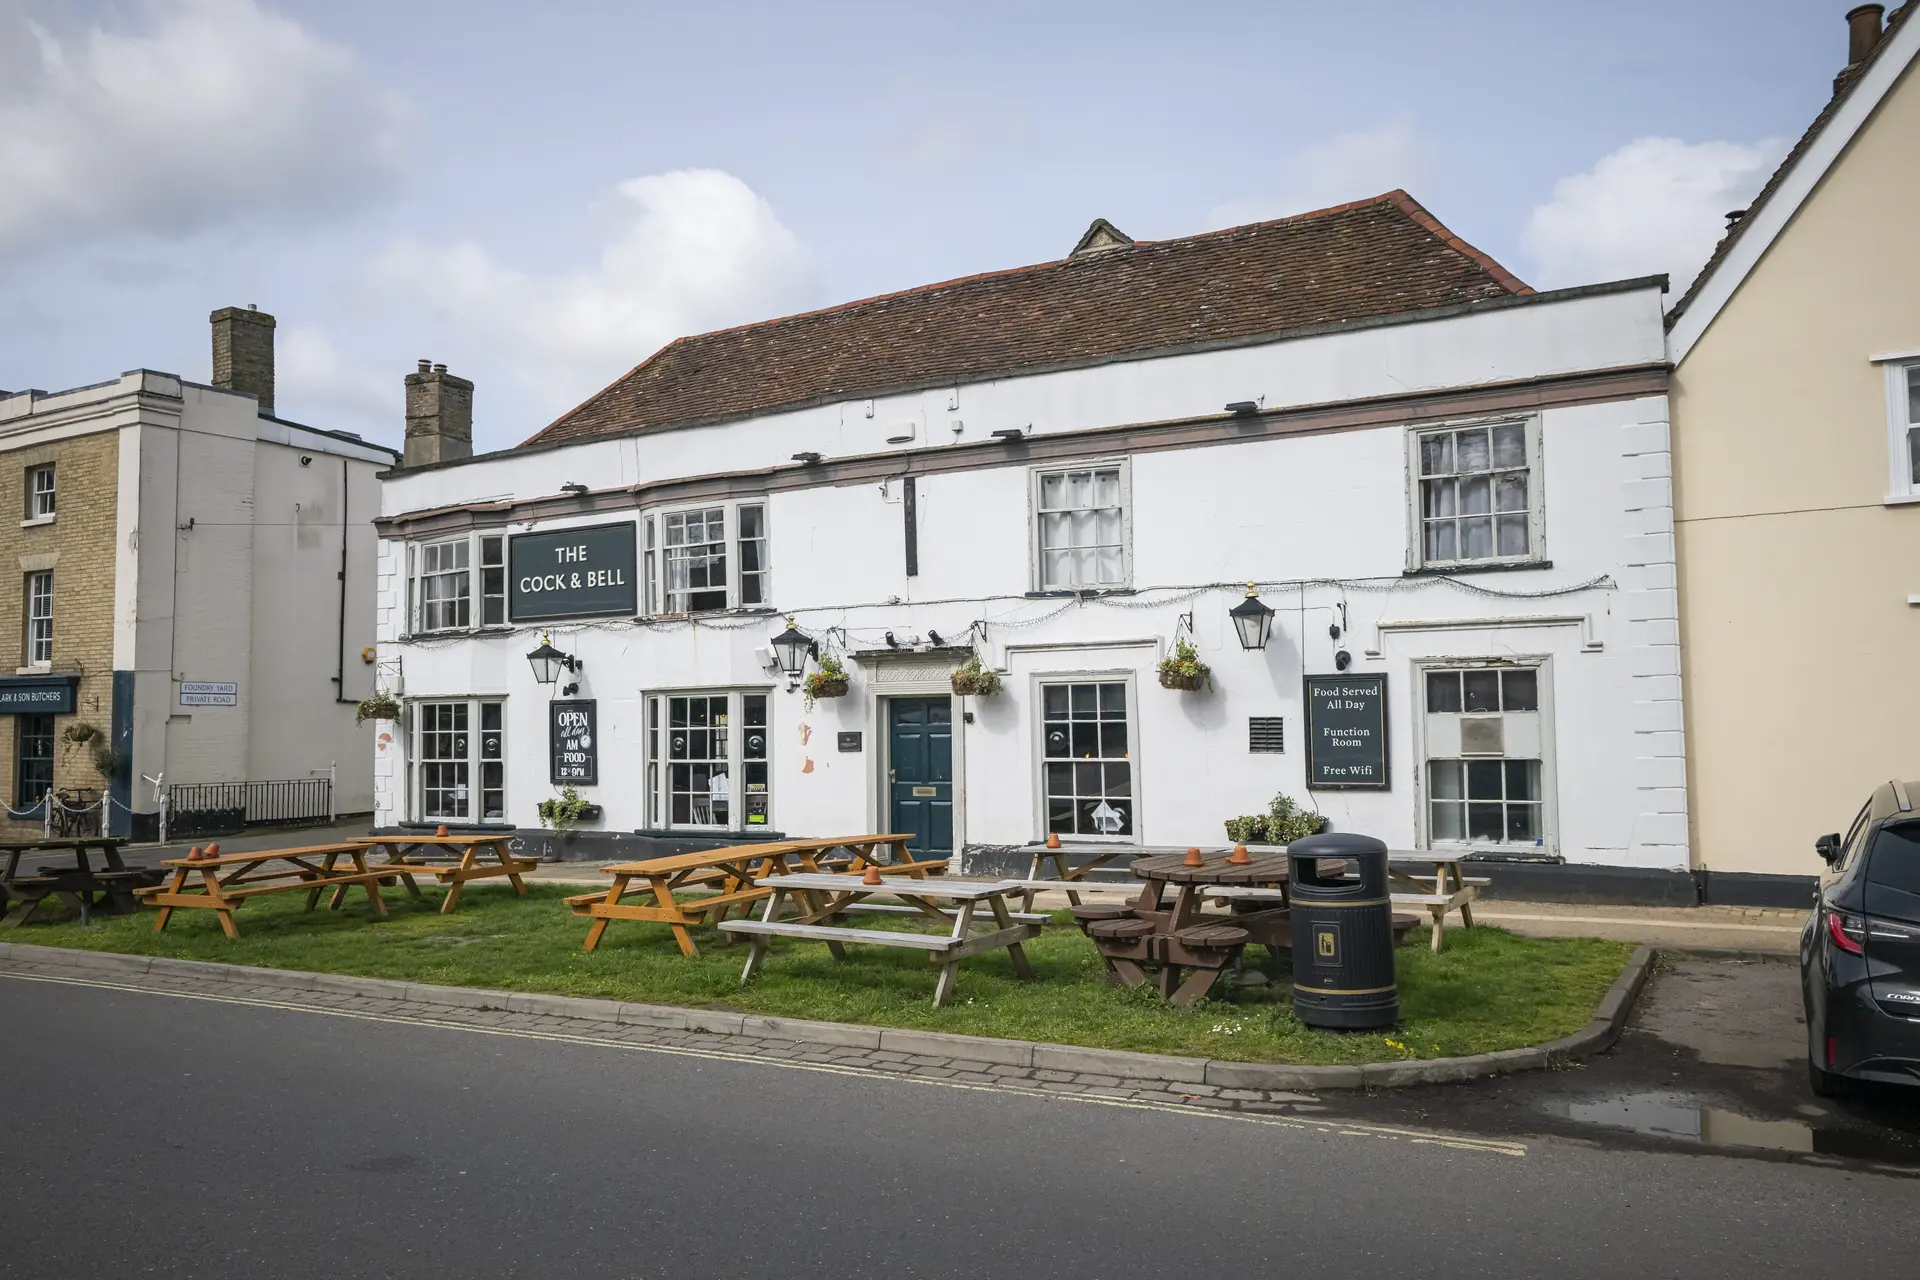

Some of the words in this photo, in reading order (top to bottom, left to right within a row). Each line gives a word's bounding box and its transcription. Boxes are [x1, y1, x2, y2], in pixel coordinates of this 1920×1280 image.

[555, 545, 587, 564] THE
[520, 573, 567, 593] COCK
[570, 572, 582, 589] &
[587, 568, 625, 588] BELL
[0, 692, 12, 702] ARK
[13, 693, 17, 702] &
[18, 692, 30, 702] SON
[31, 691, 61, 702] BUTCHERS
[1314, 687, 1339, 697] Food
[1342, 686, 1378, 696] Served
[186, 695, 211, 703] PRIVATE
[1327, 700, 1341, 709] All
[1345, 700, 1365, 711] Day
[558, 712, 588, 727] OPEN
[1323, 727, 1370, 736] Function
[566, 739, 578, 750] AM
[1332, 738, 1362, 747] Room
[563, 752, 586, 763] FOOD
[1323, 766, 1346, 775] Free
[1349, 765, 1373, 775] Wifi
